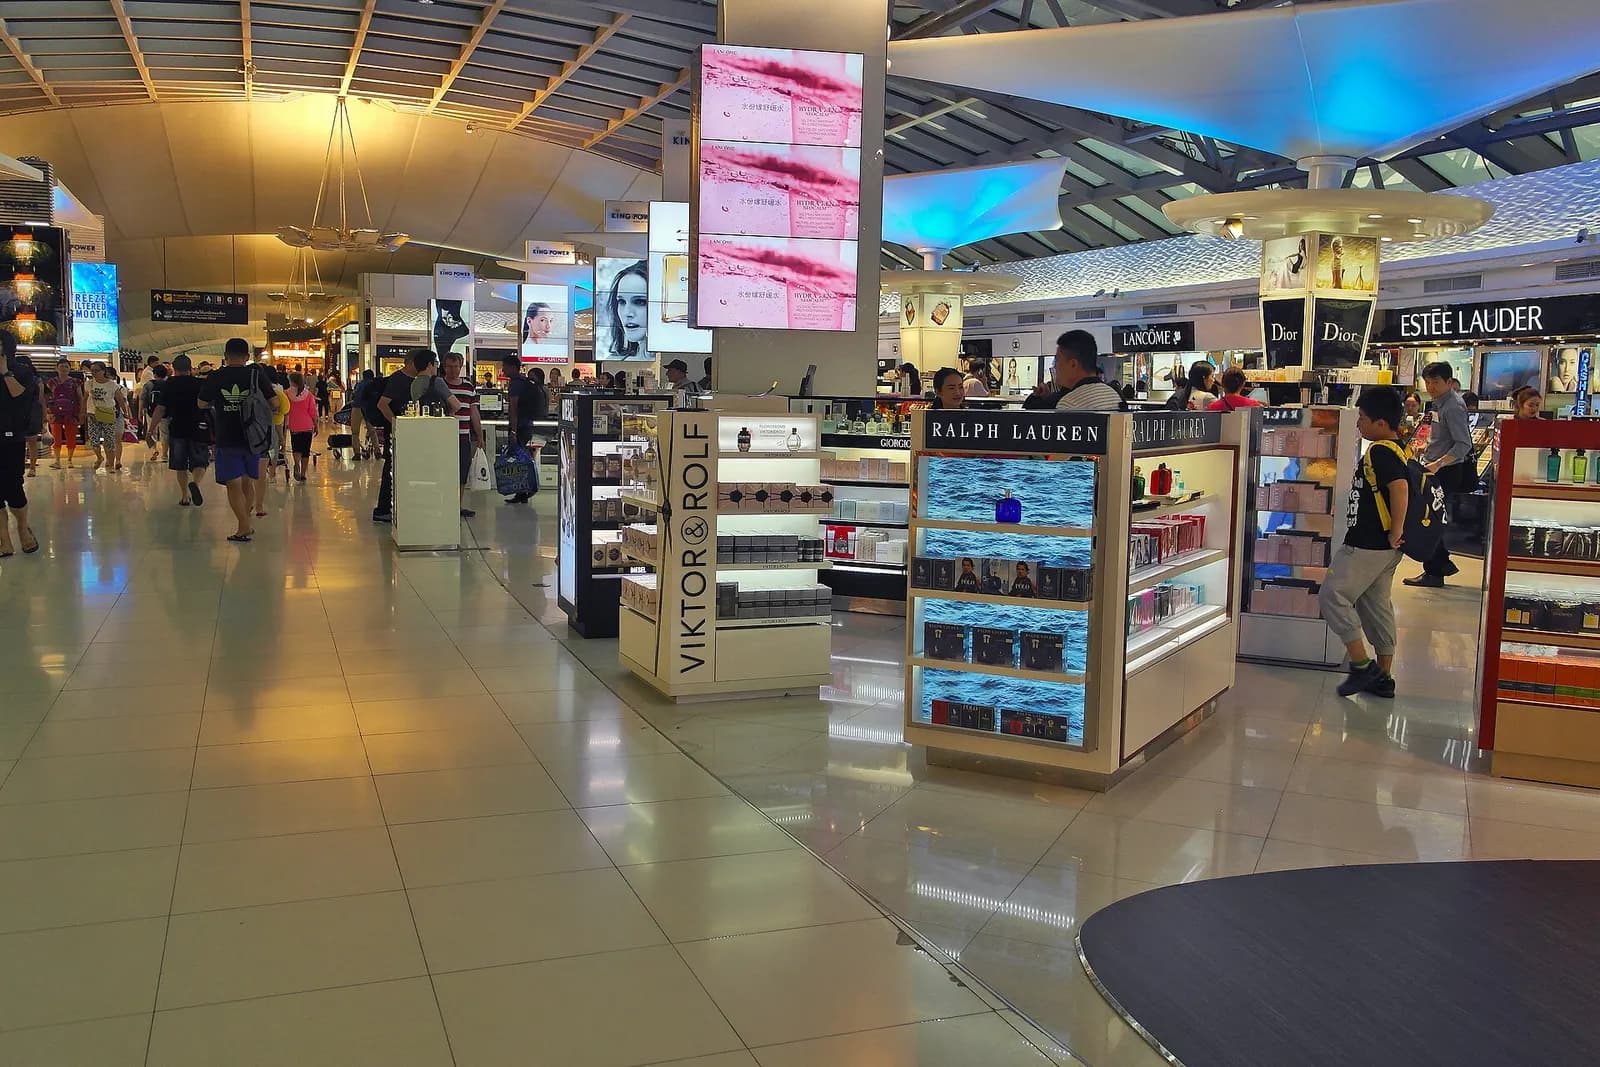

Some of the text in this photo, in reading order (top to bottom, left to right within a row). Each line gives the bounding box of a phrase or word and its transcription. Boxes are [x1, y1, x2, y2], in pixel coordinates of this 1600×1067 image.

[672, 136, 690, 145] KIN
[532, 248, 549, 256] KING
[1459, 305, 1543, 334] LAUDER
[1123, 329, 1171, 346] LANCÔME
[1271, 323, 1298, 341] Dior
[1321, 322, 1358, 342] Dior
[1577, 353, 1589, 416] CASHIER
[932, 422, 1100, 442] RALPH LAUREN
[1131, 418, 1207, 443] RALPH LAUREN
[880, 438, 911, 449] GIORGIO
[630, 566, 647, 574] DIESEL
